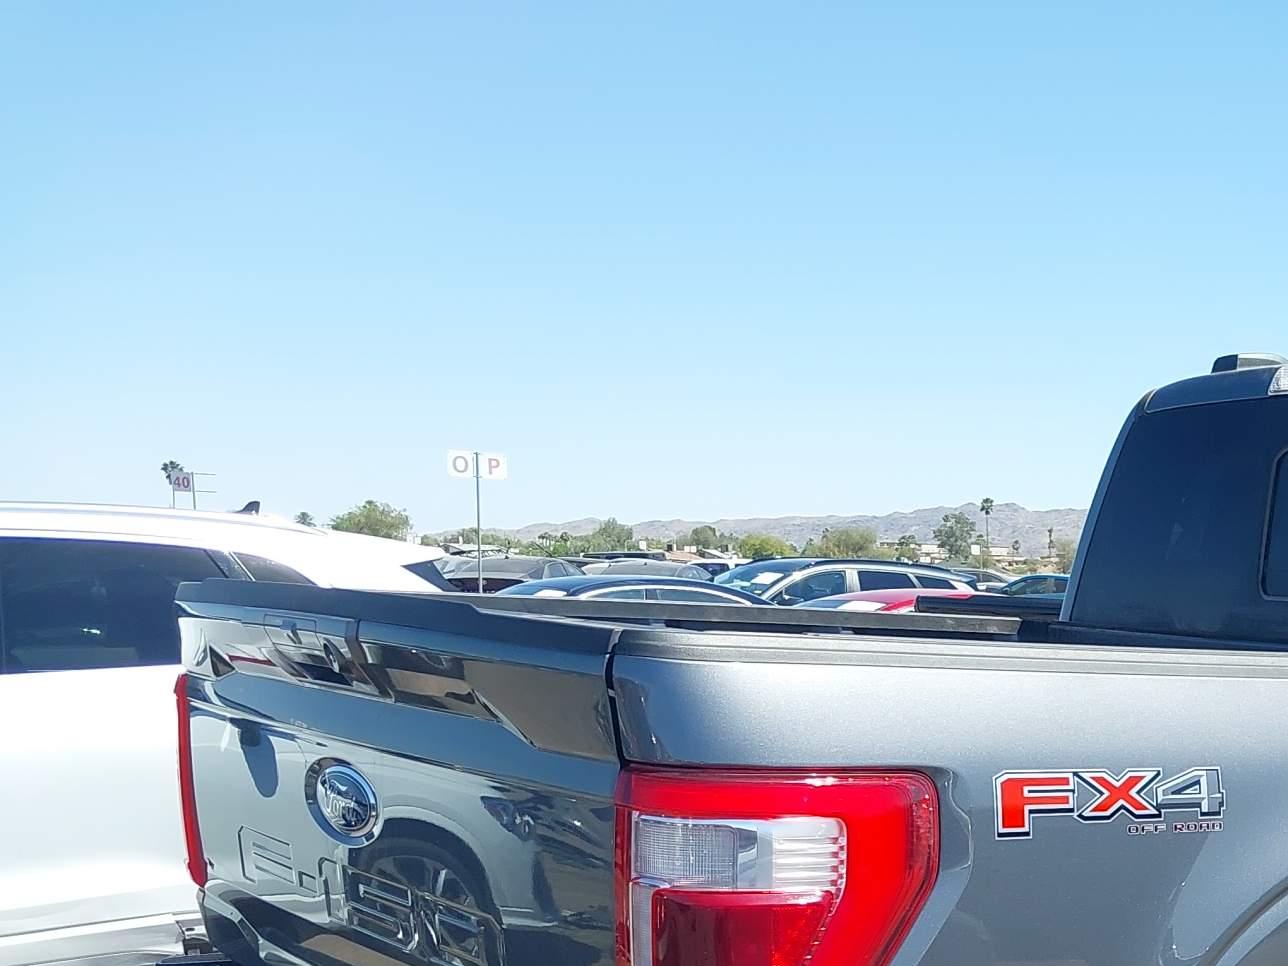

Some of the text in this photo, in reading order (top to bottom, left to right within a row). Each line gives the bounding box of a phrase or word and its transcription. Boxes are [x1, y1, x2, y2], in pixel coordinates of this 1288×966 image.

[452, 455, 469, 473] O
[487, 457, 501, 475] P
[173, 476, 190, 489] 40
[993, 767, 1226, 840] FX4
[1127, 821, 1224, 835] OFF ROAD
